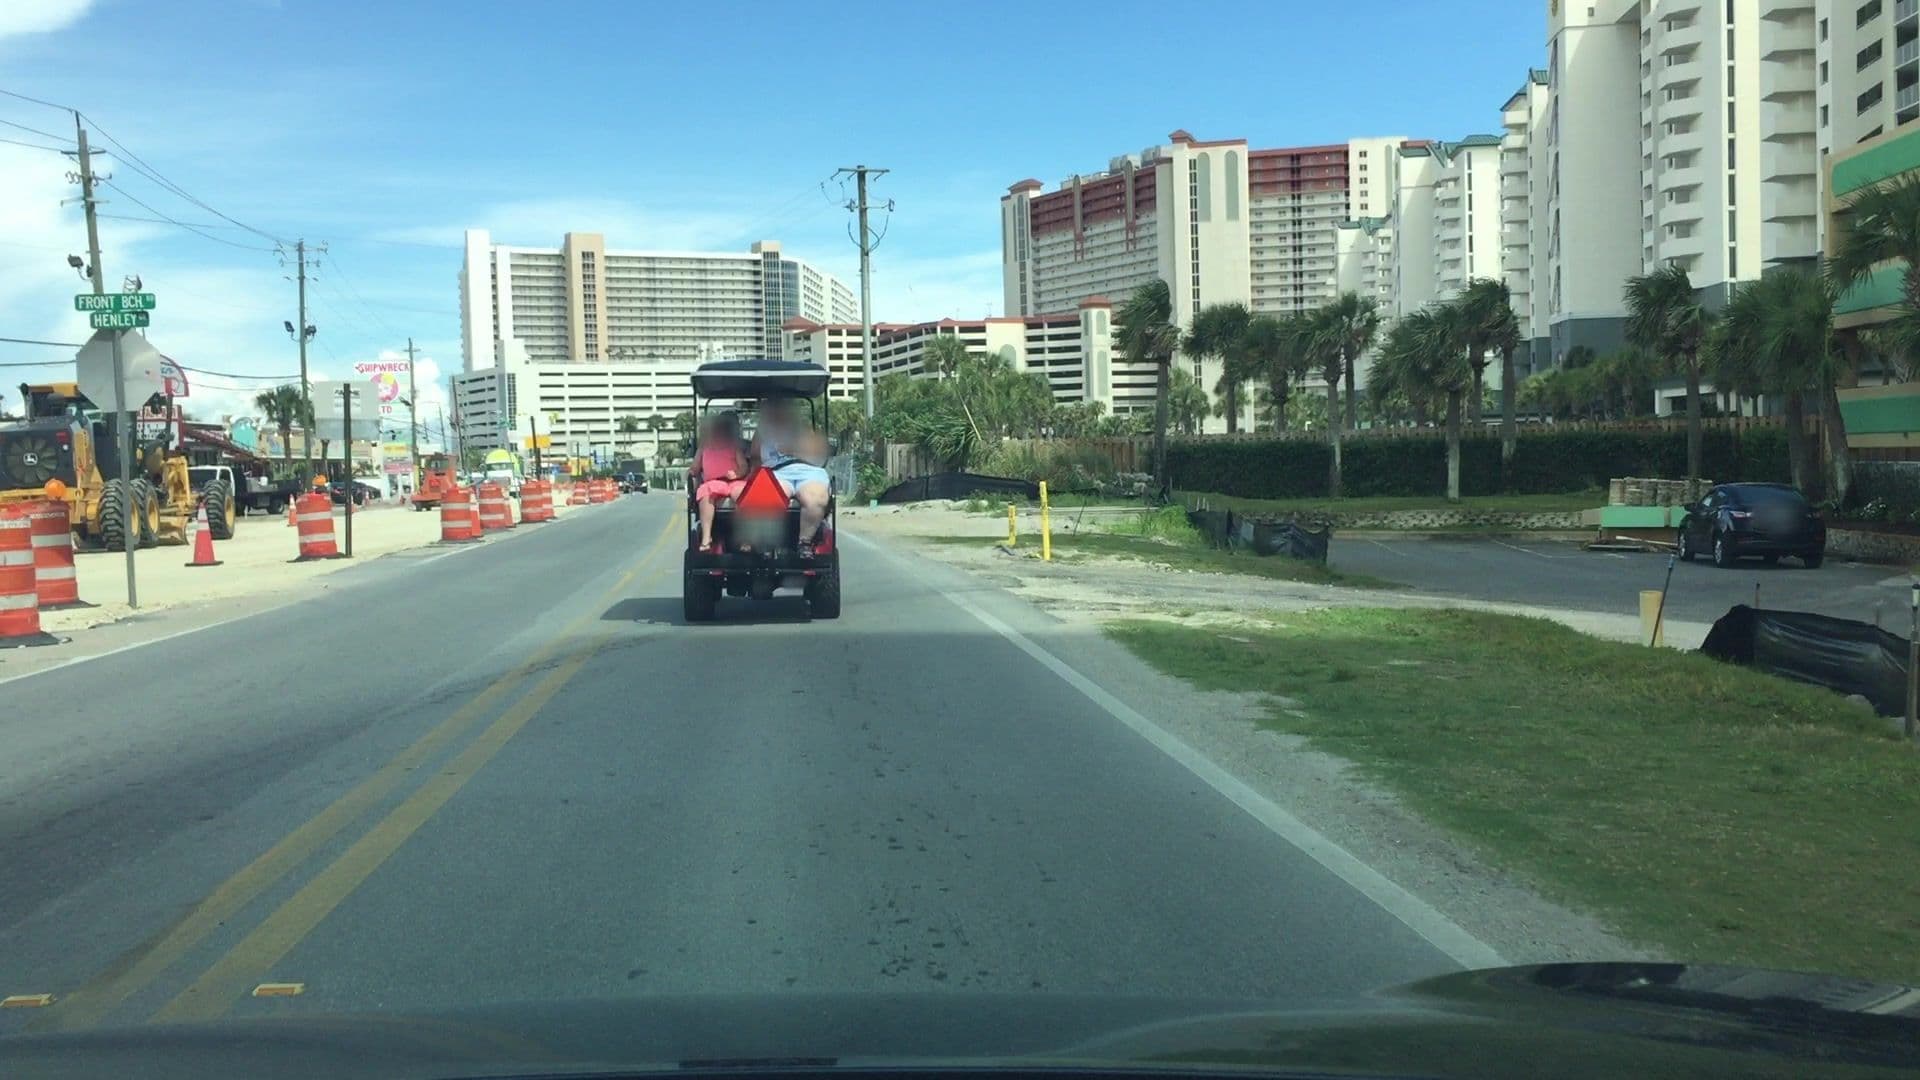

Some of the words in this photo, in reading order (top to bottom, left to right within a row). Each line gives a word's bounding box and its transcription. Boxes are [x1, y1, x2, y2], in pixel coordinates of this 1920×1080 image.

[78, 295, 115, 309] FRONT
[94, 313, 137, 327] HENLEY
[355, 362, 409, 374] SHIPWRECK
